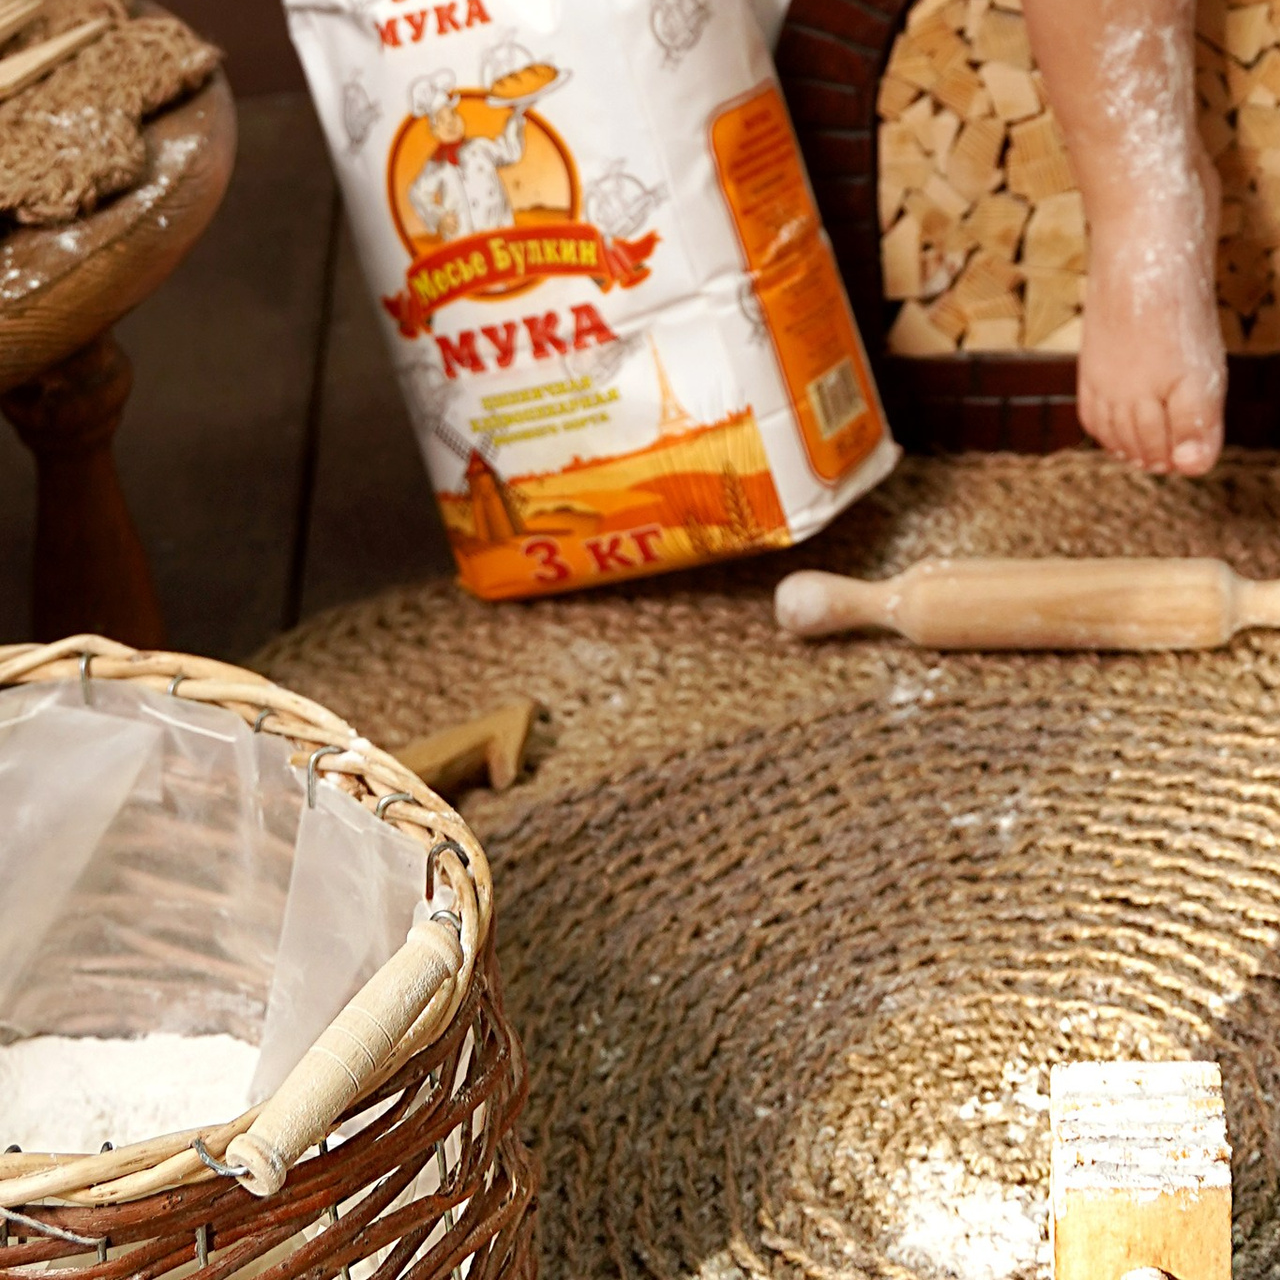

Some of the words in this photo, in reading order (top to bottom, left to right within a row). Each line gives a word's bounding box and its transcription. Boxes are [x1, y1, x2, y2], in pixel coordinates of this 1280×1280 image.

[412, 250, 488, 304] Месье
[487, 238, 597, 276] Булкин
[435, 302, 618, 379] МУКА
[523, 537, 569, 581] 3
